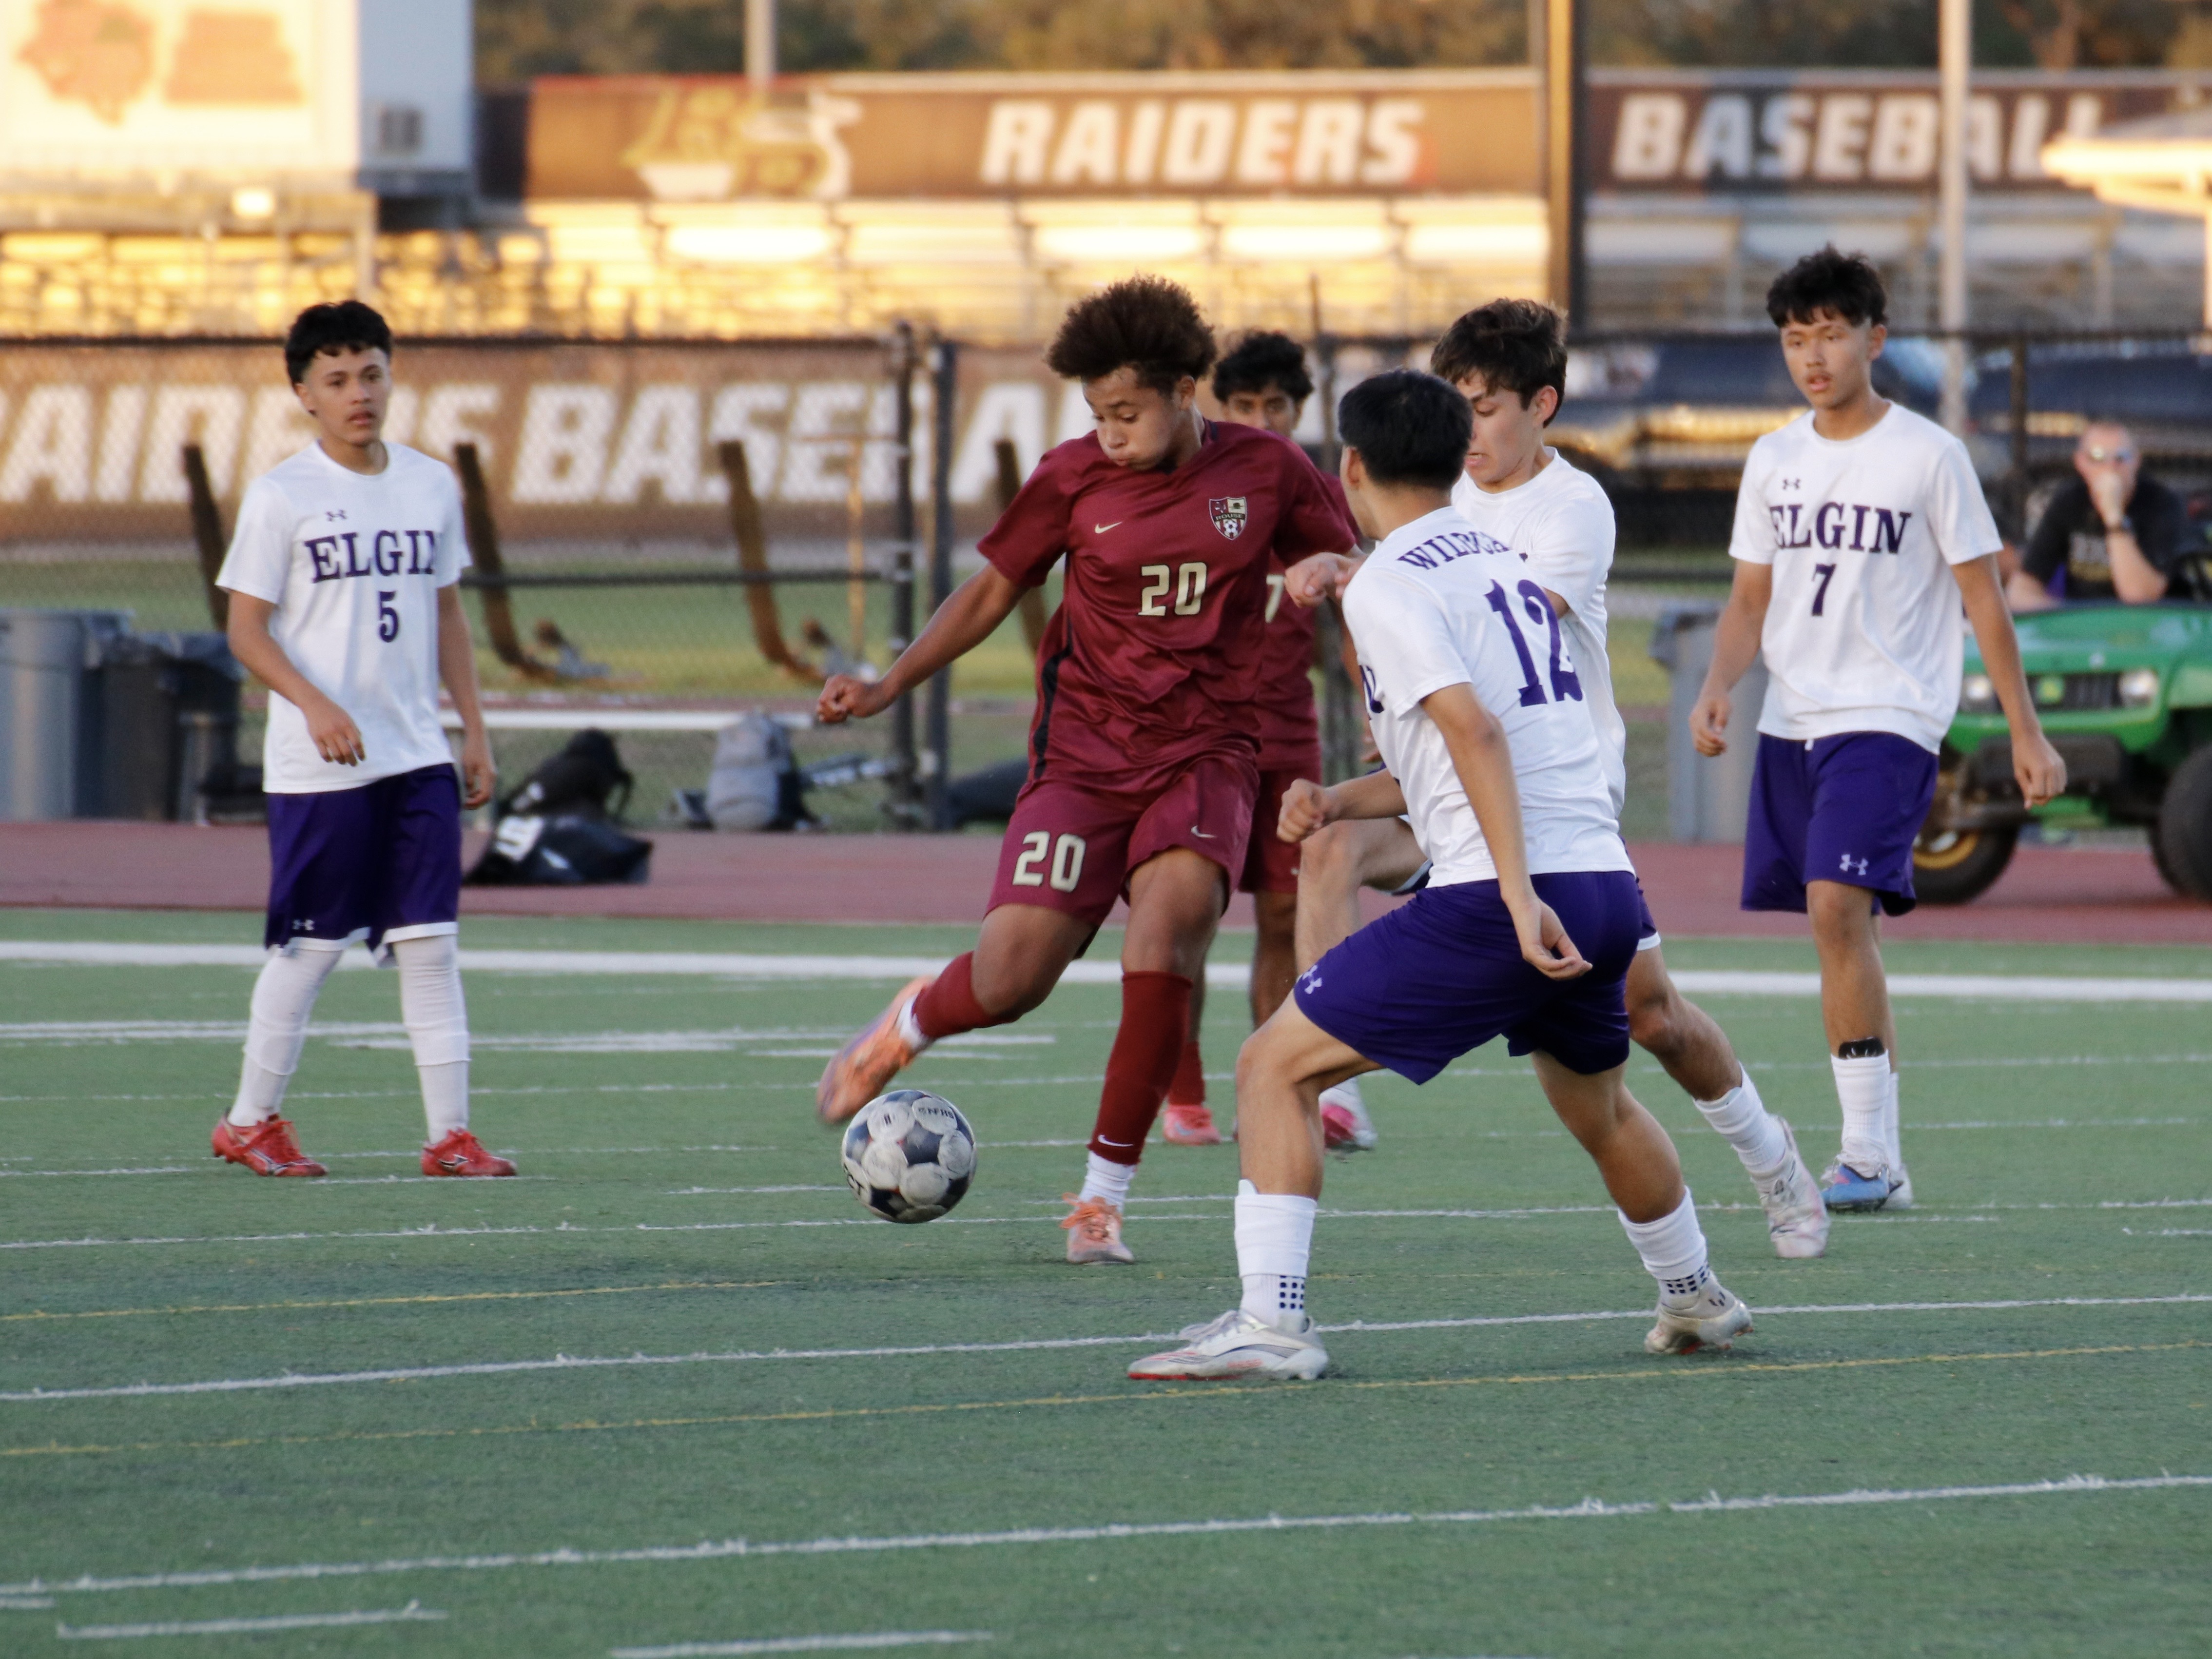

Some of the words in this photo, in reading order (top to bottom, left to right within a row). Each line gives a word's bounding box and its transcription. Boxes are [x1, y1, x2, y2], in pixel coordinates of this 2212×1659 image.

[981, 101, 1428, 184] RAIDERS
[0, 383, 501, 504] AIDES
[1769, 502, 1912, 555] ELGIN
[1138, 562, 1207, 616] 20
[1265, 574, 1285, 623] 7
[1811, 564, 1837, 616] 7
[378, 591, 399, 643] 5
[1484, 579, 1583, 707] 12
[1012, 831, 1086, 893] 20
